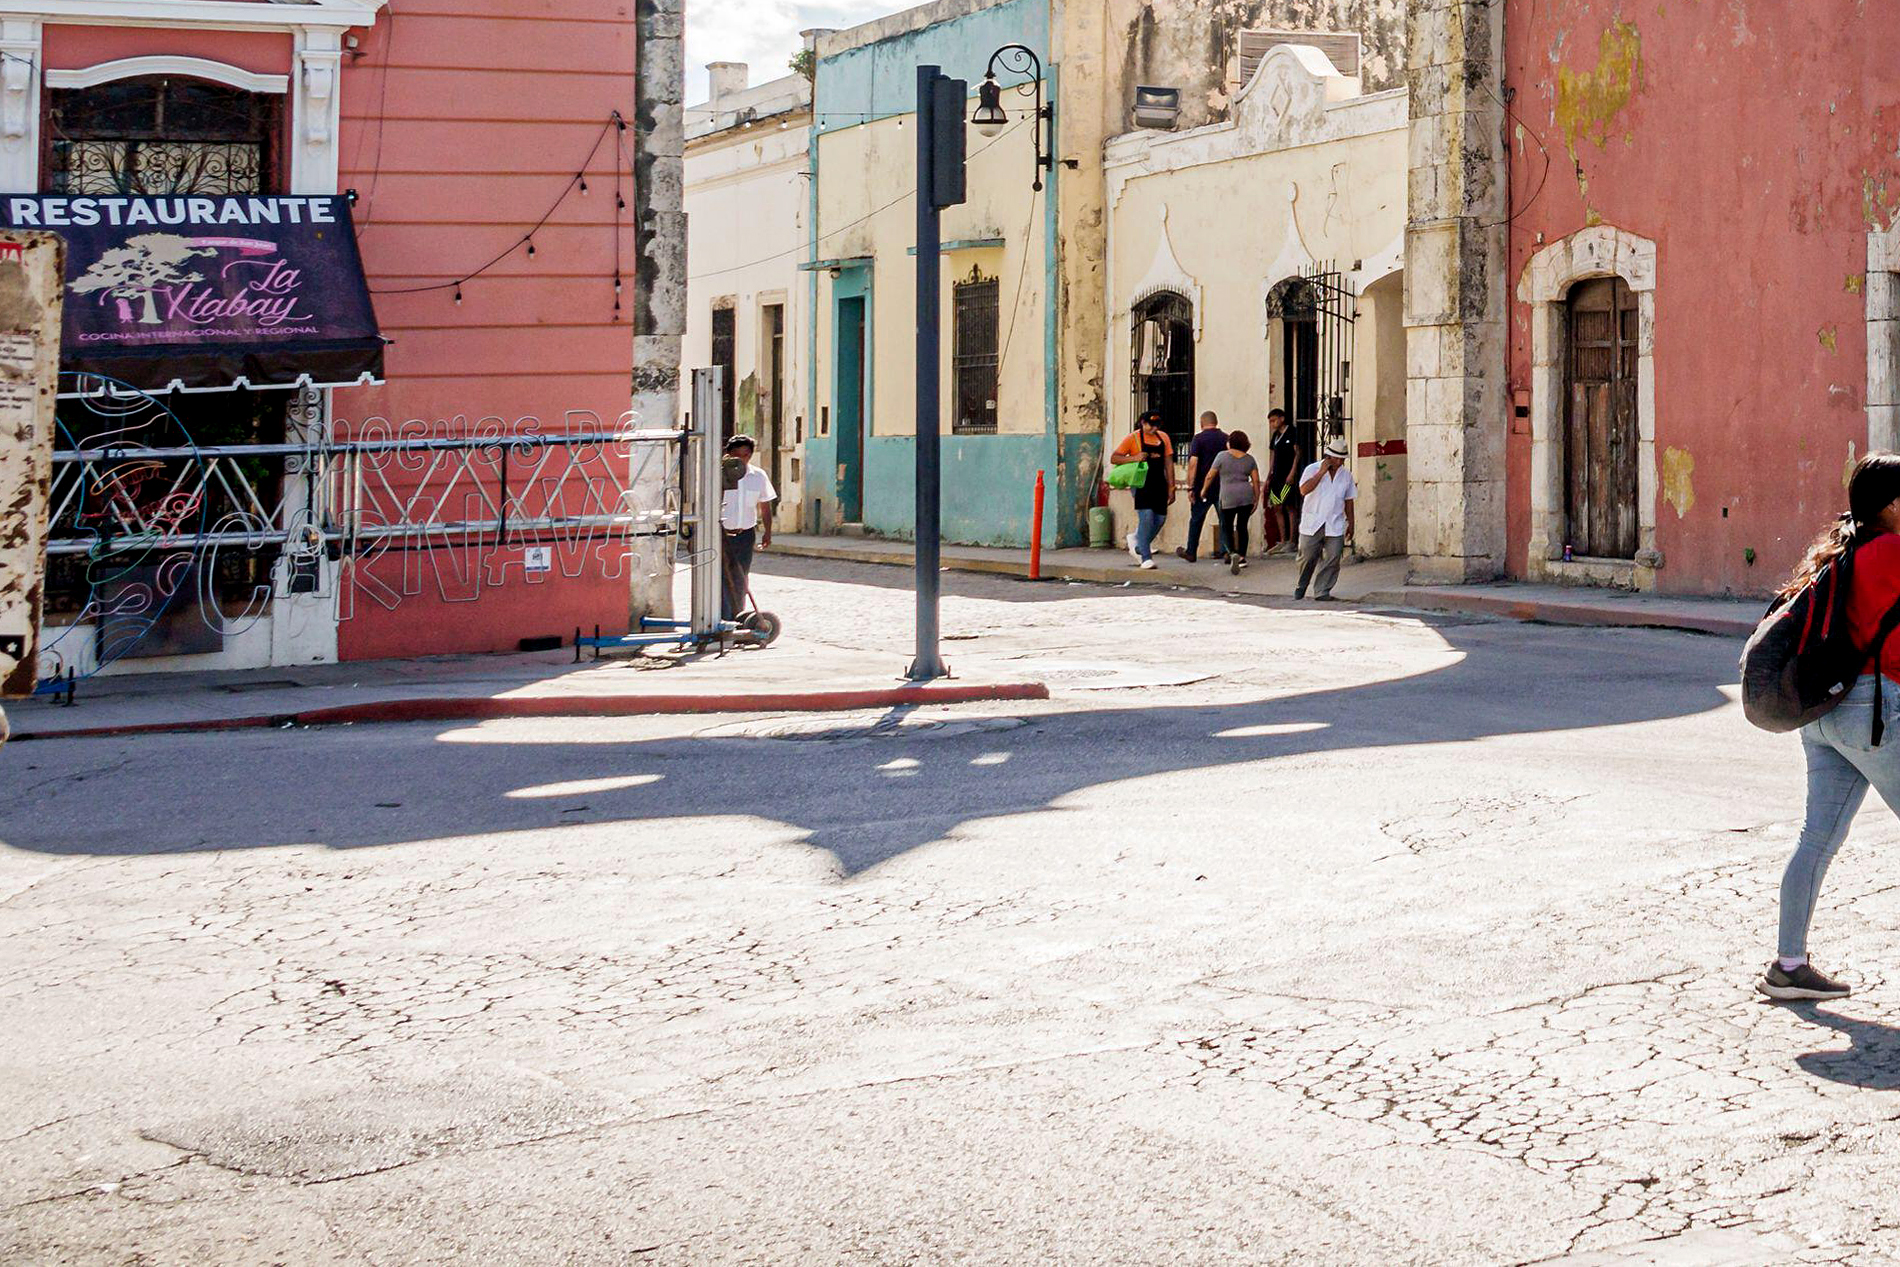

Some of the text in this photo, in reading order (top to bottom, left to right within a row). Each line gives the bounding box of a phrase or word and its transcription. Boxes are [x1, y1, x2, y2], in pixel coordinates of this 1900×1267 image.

[10, 198, 335, 226] RESTAURANTE
[222, 259, 302, 293] La
[100, 282, 314, 326] Xtabay
[79, 332, 135, 341] COCINA
[137, 328, 240, 339] INTERNACIONAL
[255, 325, 320, 336] REGIONAL
